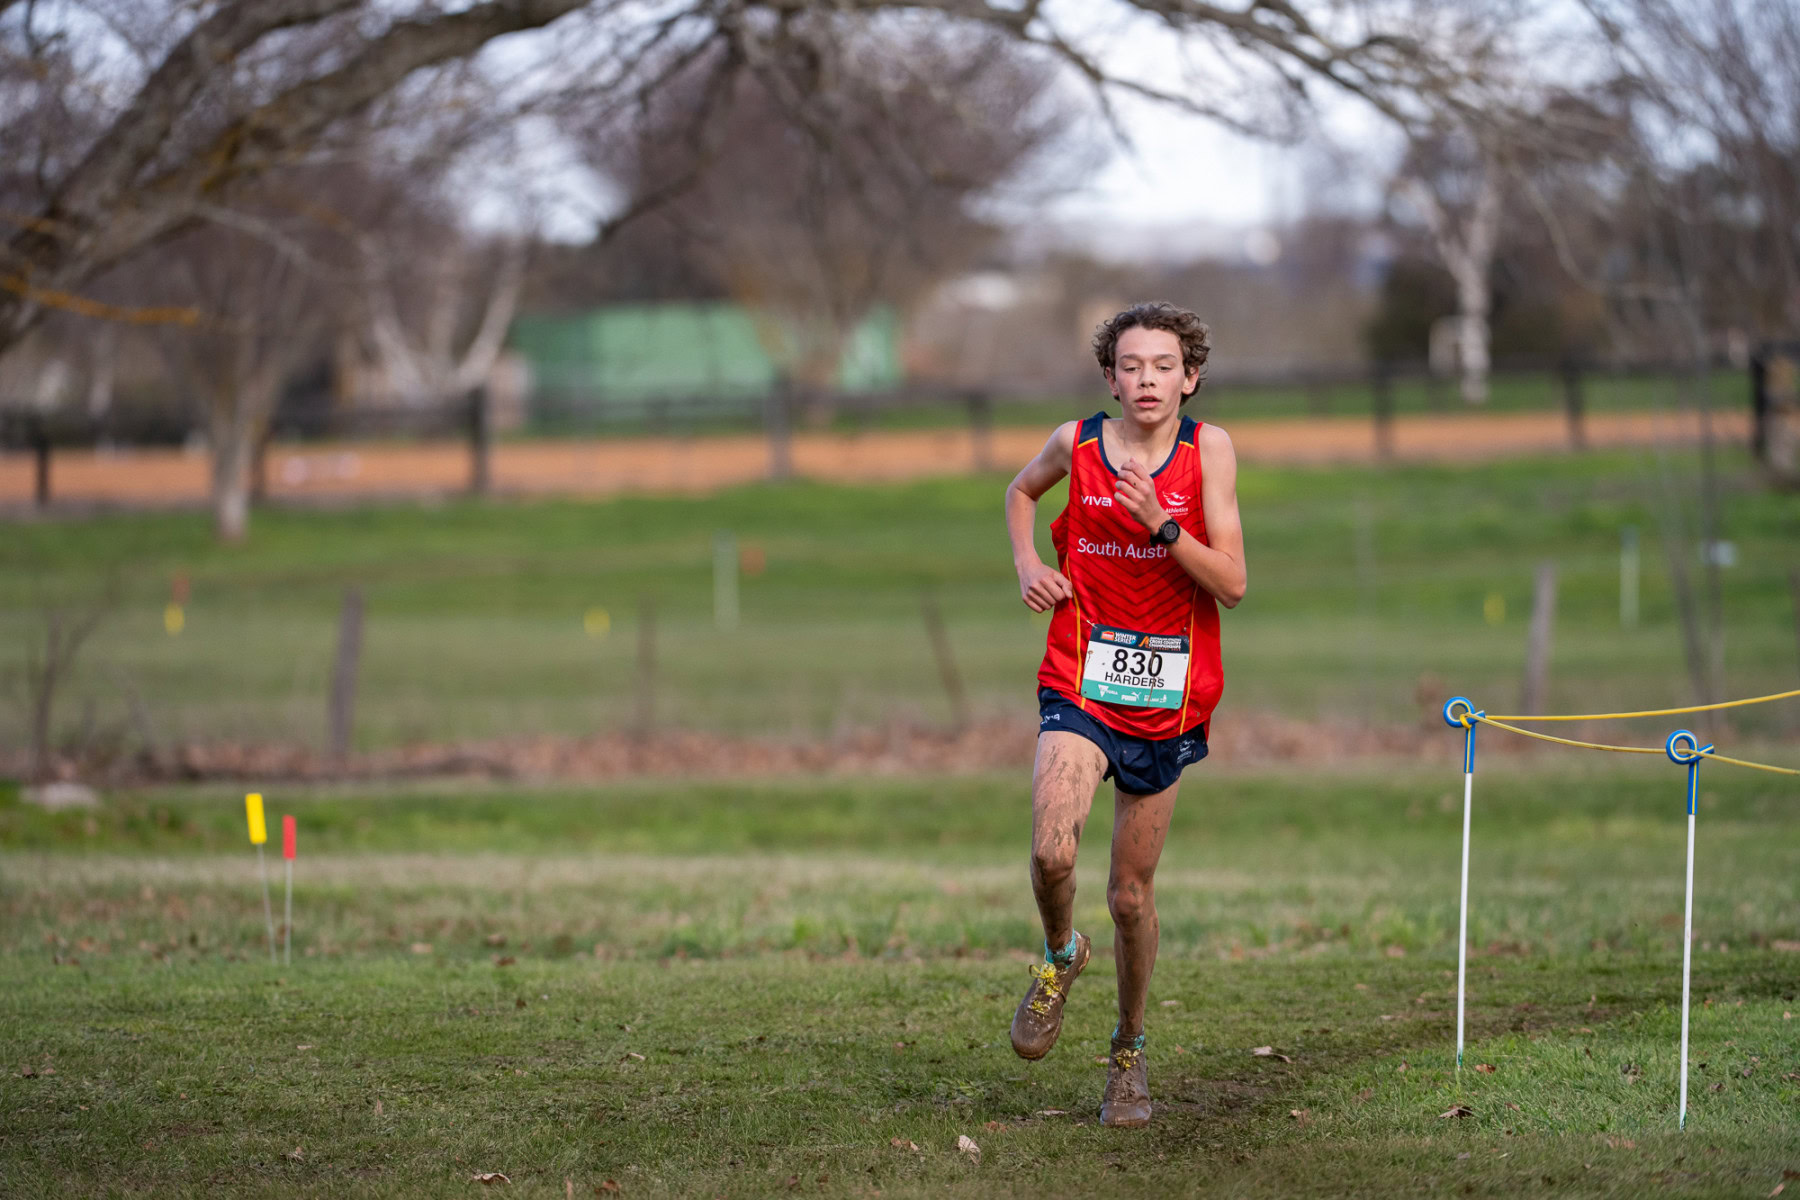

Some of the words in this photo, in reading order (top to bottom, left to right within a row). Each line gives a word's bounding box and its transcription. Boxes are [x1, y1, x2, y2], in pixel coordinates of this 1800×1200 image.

[1077, 537, 1122, 557] South
[1112, 649, 1163, 677] 830
[1104, 671, 1165, 688] HARDERS
